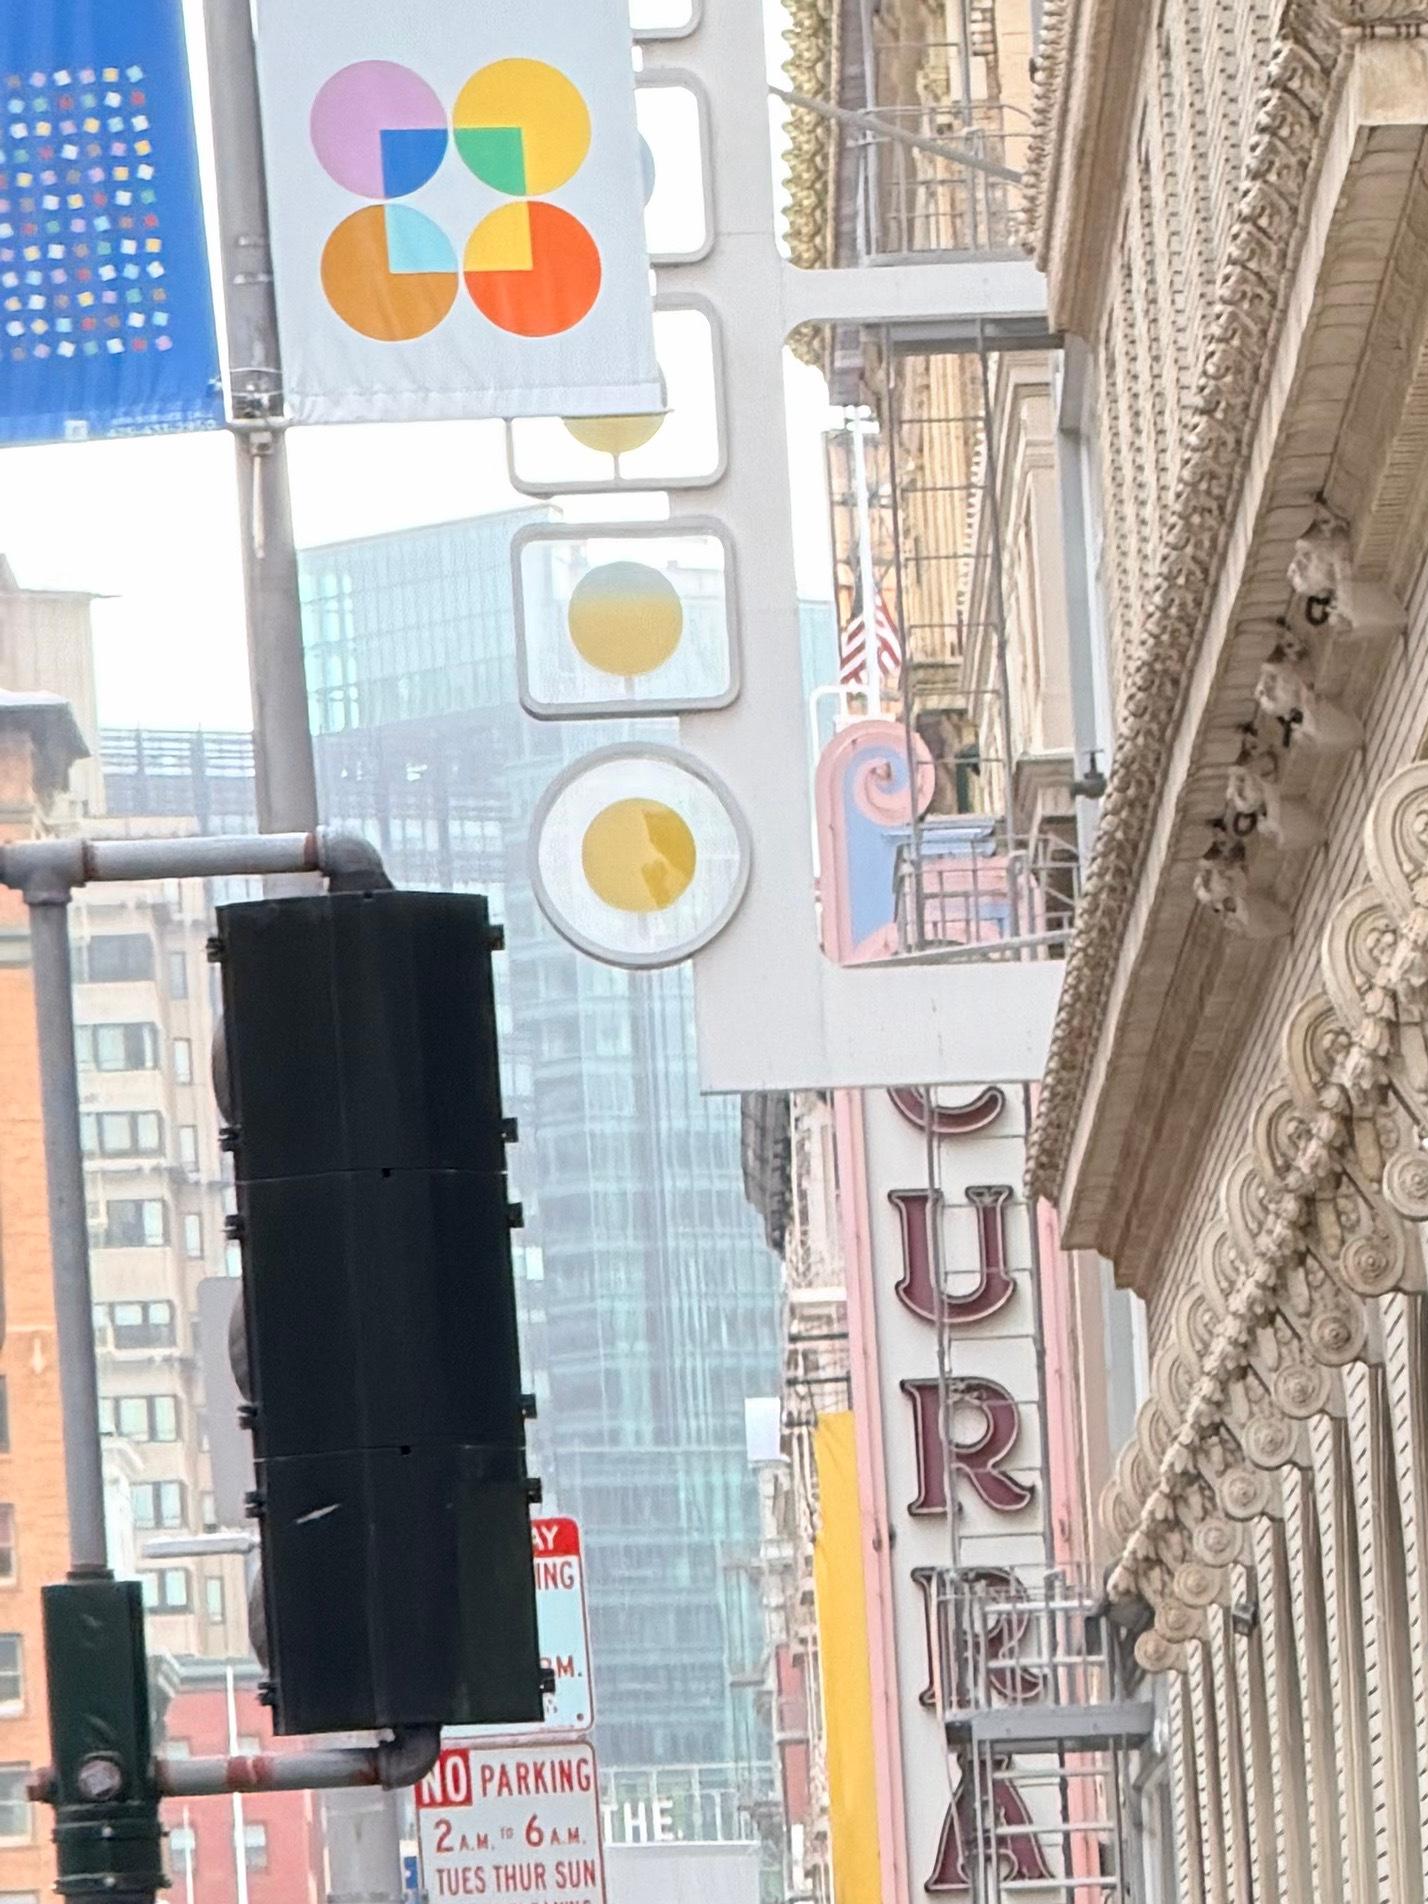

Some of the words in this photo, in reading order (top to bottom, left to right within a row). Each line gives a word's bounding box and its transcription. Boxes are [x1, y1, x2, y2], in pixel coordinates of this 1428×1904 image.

[421, 1754, 468, 1804] NO
[480, 1758, 592, 1798] PARKING
[434, 1818, 454, 1854] 2
[524, 1813, 545, 1848] 6
[436, 1865, 486, 1897] TUES
[493, 1861, 548, 1893] THUR
[554, 1858, 597, 1889] SUN
